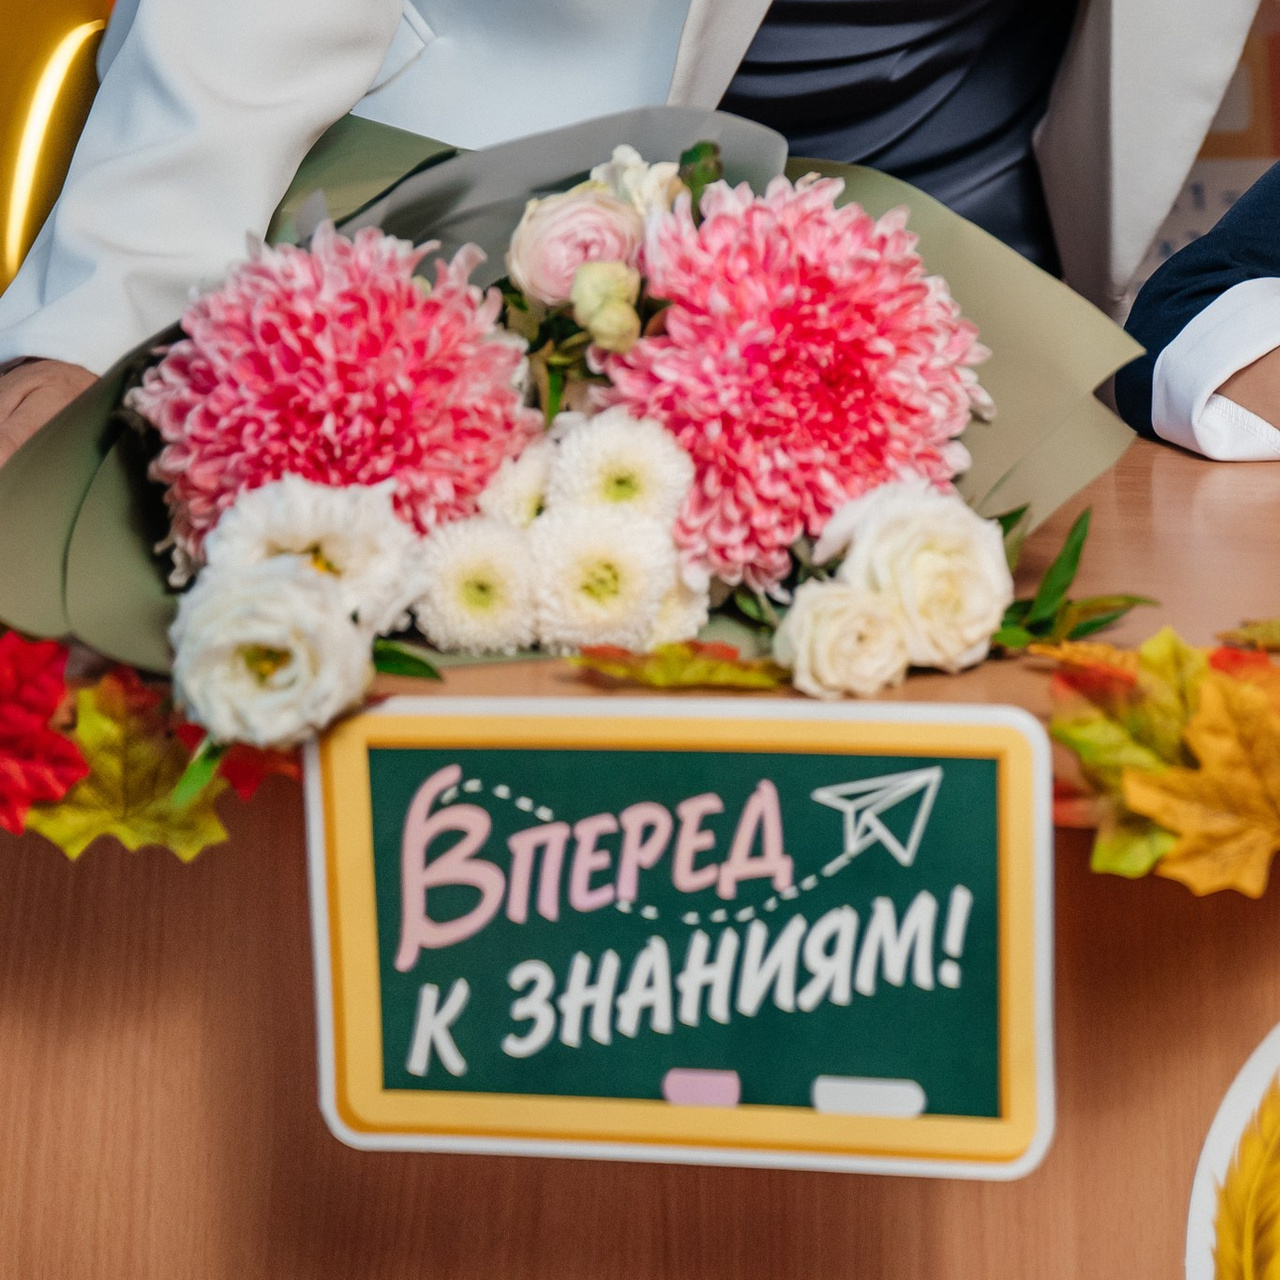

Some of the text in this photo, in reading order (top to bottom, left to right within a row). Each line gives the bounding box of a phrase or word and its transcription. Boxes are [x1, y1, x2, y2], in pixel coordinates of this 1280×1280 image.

[394, 763, 794, 972] ВПЕРЕД
[406, 883, 973, 1076] К ЗНАНИЯМ!
